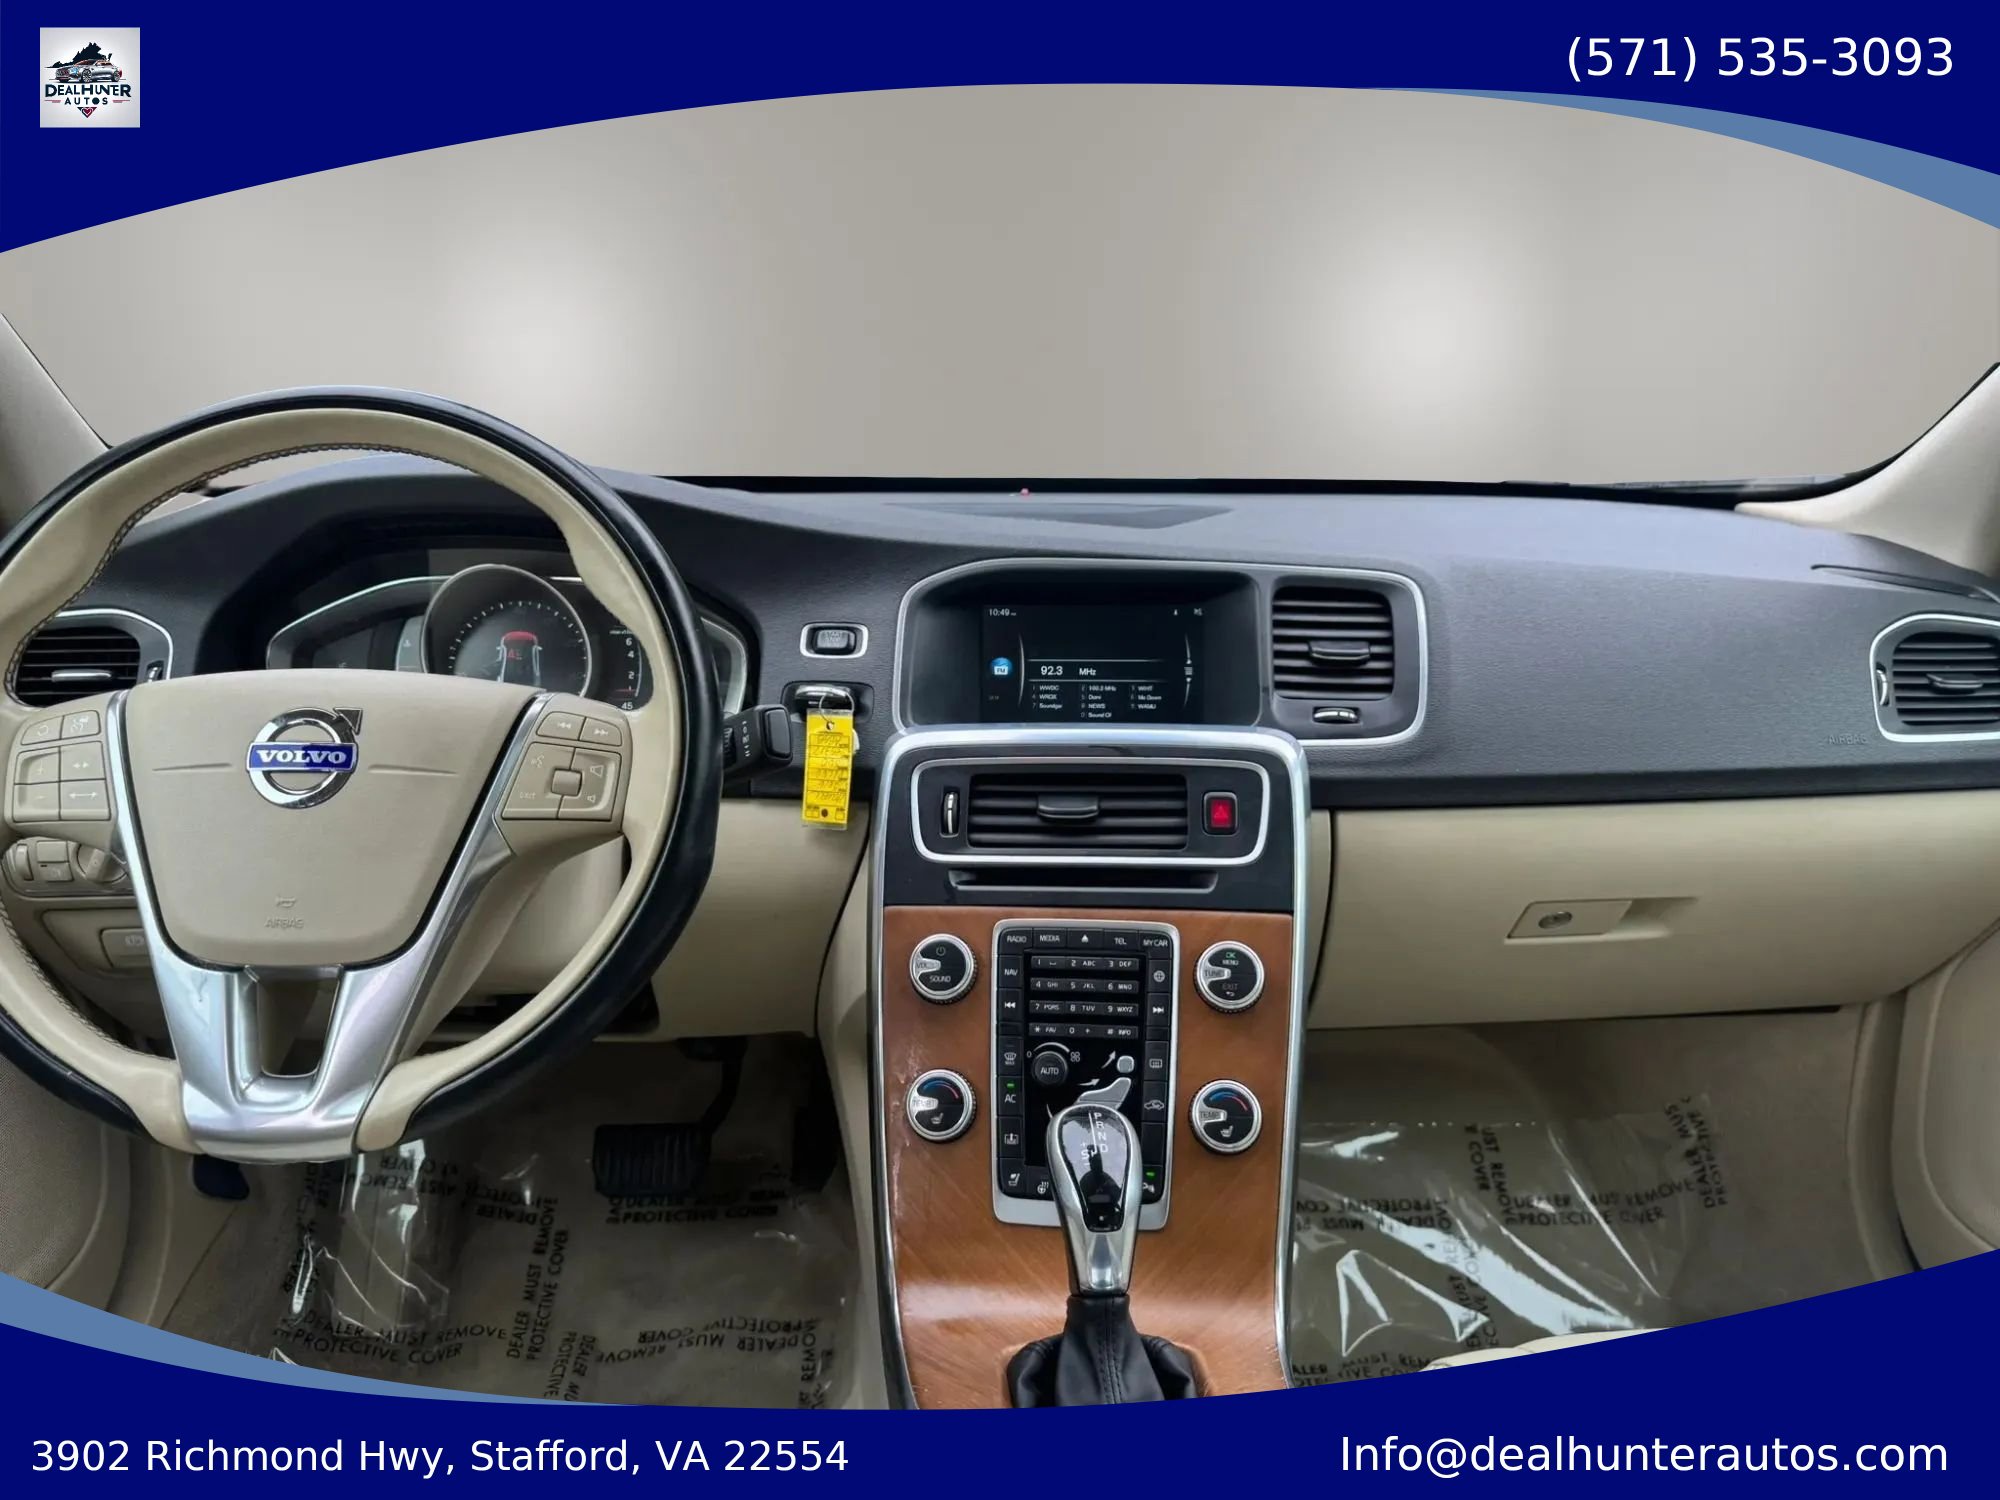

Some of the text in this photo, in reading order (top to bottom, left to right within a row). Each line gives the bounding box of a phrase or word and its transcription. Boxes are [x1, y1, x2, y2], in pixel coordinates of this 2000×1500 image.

[988, 608, 1010, 617] 10:49
[626, 637, 632, 646] 6
[628, 651, 634, 659] 4
[1040, 665, 1097, 676] 92.3 MHz
[621, 701, 633, 711] 45
[256, 749, 347, 764] VOLVO
[1006, 935, 1027, 943] RADIO
[1039, 934, 1060, 942] MEDIA
[1114, 937, 1127, 945] TEL
[1225, 951, 1236, 959] OK
[1004, 968, 1018, 976] NAV
[929, 975, 951, 983] SOUND
[1070, 1004, 1076, 1012] 8
[1040, 1066, 1059, 1075] AUTO
[1004, 1094, 1016, 1103] AC
[1093, 1112, 1102, 1120] P
[1095, 1121, 1104, 1130] R
[1097, 1131, 1107, 1141] N
[1100, 1143, 1109, 1153] D
[526, 1228, 570, 1361] PROTECTIVE COVER
[506, 1310, 531, 1360] DEALER
[522, 1262, 543, 1302] MUST
[437, 1322, 509, 1345] REMOVE
[638, 1327, 694, 1344] COVER
[292, 1327, 464, 1365] PROTECTIVE COVER
[736, 1333, 798, 1352] DEALER
[544, 1331, 578, 1398] PROTECTIVE
